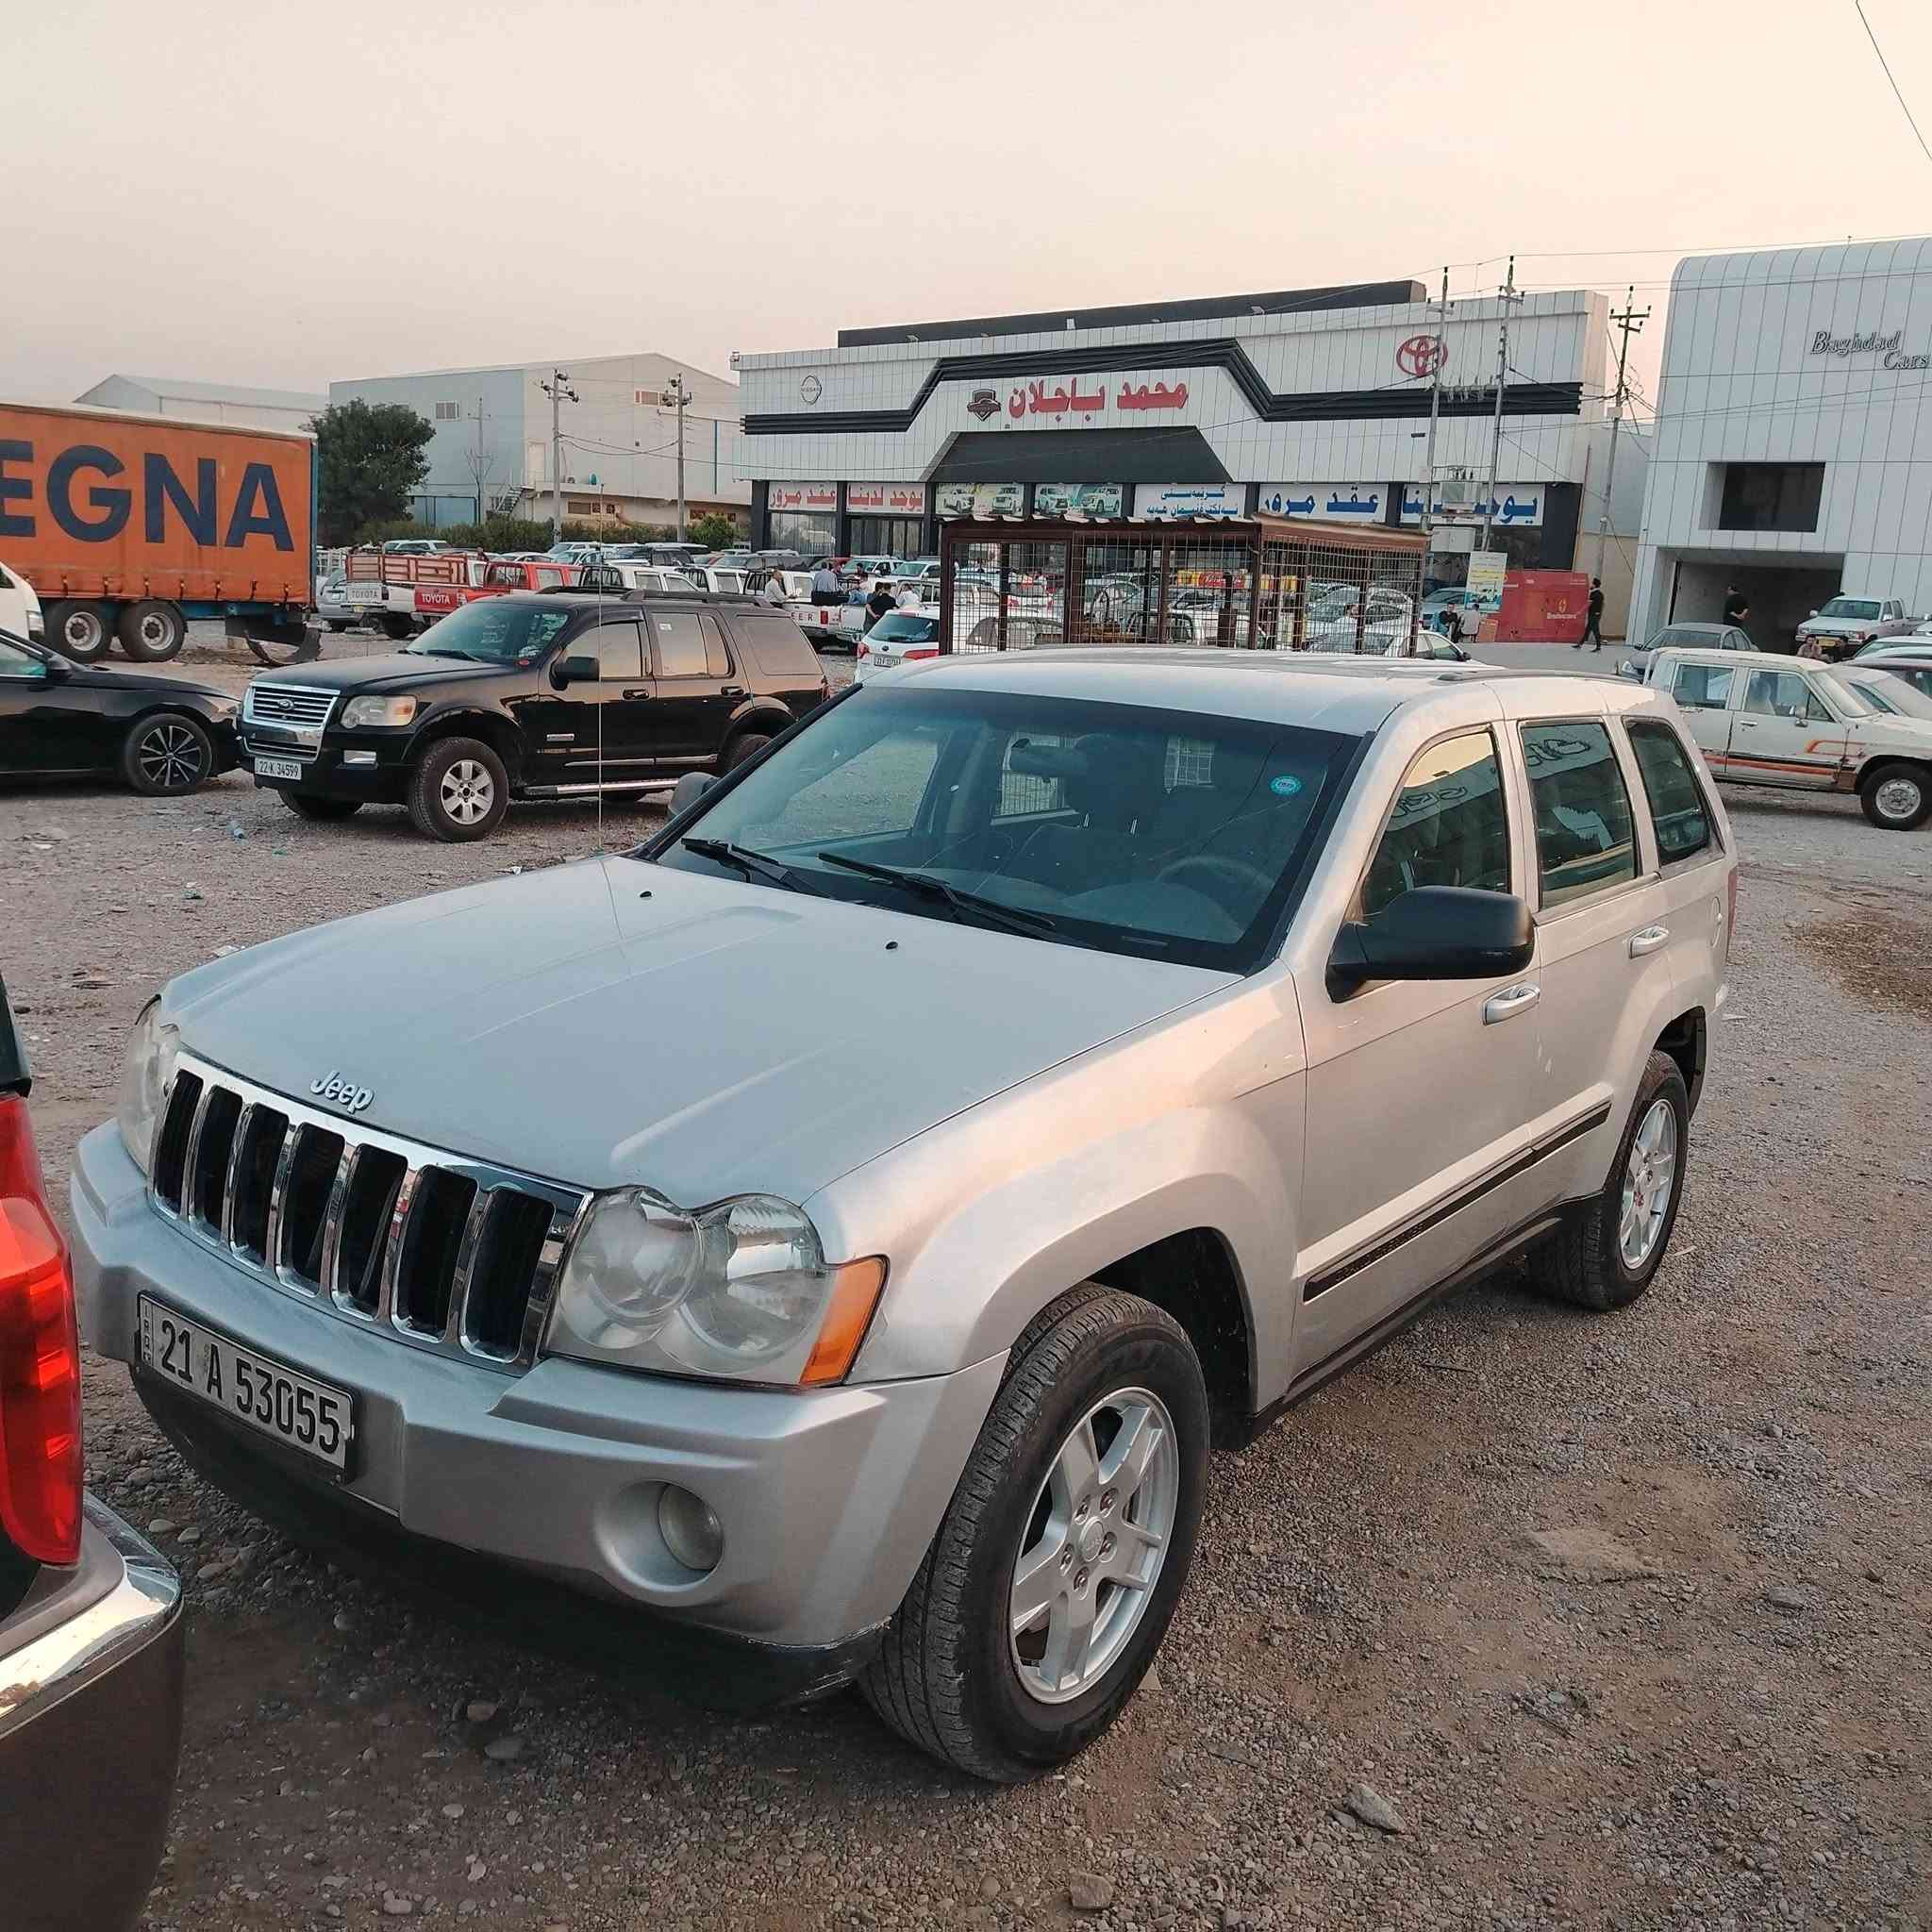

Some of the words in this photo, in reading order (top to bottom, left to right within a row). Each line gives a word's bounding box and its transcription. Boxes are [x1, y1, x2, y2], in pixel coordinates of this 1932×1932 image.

[1810, 330, 1902, 358] Baghdad
[1884, 350, 1931, 371] Cars
[1008, 376, 1106, 424] باجلان
[1117, 381, 1190, 411] محمد
[0, 439, 295, 553] EGNA
[1325, 486, 1379, 514] عقد
[352, 590, 377, 599] TOYOTA
[422, 592, 451, 605] TOYOTA
[310, 1070, 375, 1114] Jeep
[161, 1320, 193, 1384] 21
[207, 1342, 223, 1401] A
[236, 1356, 341, 1455] 53055
